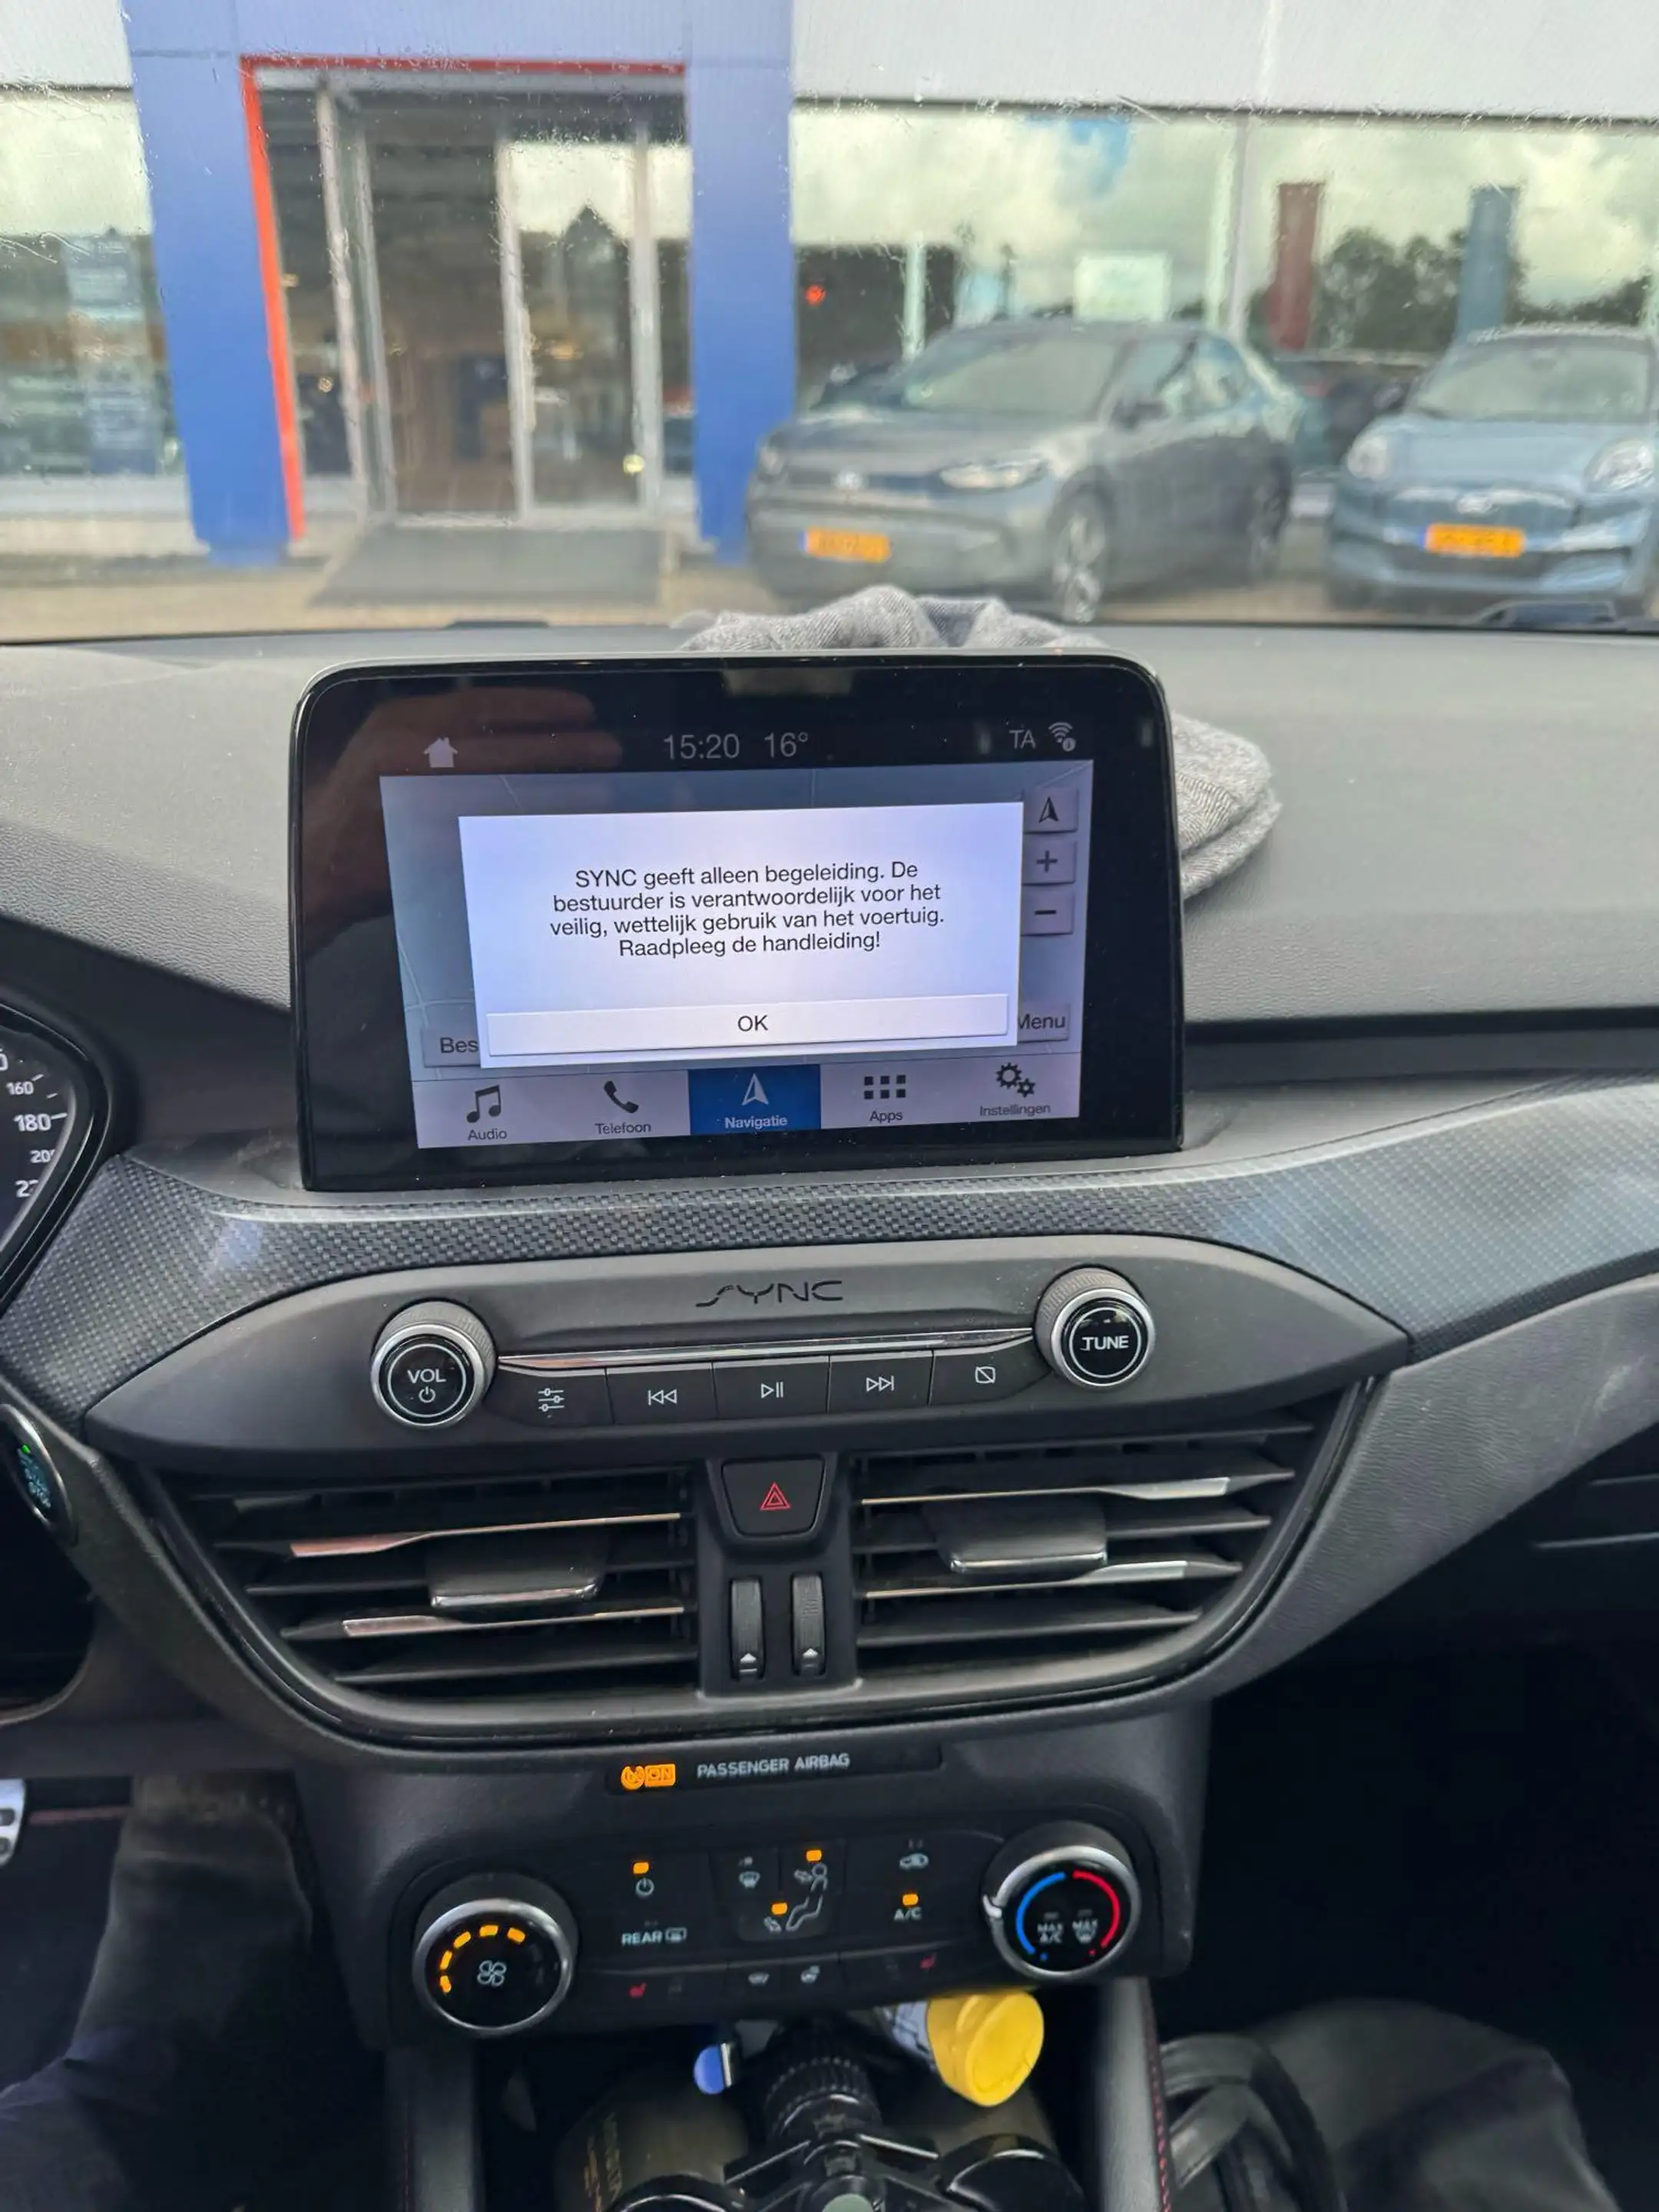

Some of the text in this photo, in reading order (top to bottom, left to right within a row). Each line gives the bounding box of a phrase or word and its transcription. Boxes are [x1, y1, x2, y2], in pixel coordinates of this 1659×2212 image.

[663, 733, 740, 760] 15:20
[763, 731, 809, 759] 16°
[1009, 730, 1036, 750] TA
[575, 861, 918, 890] SYNC geeft alleen begeleiding. De
[553, 883, 941, 912] bestuurder is verantwoordelijk voor het
[550, 906, 944, 939] veilig, wettelijk gebruik van het voertuig.
[619, 930, 880, 959] Raadpleeg de handleiding!
[737, 1015, 769, 1032] OK
[1018, 1013, 1065, 1030] Menu
[440, 1037, 478, 1053] Bes
[6, 1081, 34, 1095] 160
[869, 1110, 903, 1124] Apps
[979, 1104, 1051, 1117] Instellingen
[14, 1114, 51, 1132] 180
[594, 1122, 651, 1134] Telefoon
[724, 1114, 788, 1131] Navigatie
[467, 1128, 508, 1141] Audio
[695, 1280, 843, 1308] SYNC
[1081, 1335, 1129, 1351] TUNE
[406, 1368, 446, 1384] VOL
[697, 1758, 790, 1779] PASSENGER
[793, 1753, 851, 1772] AIRBAG
[893, 1906, 922, 1921] A/C
[621, 1930, 663, 1946] REAR
